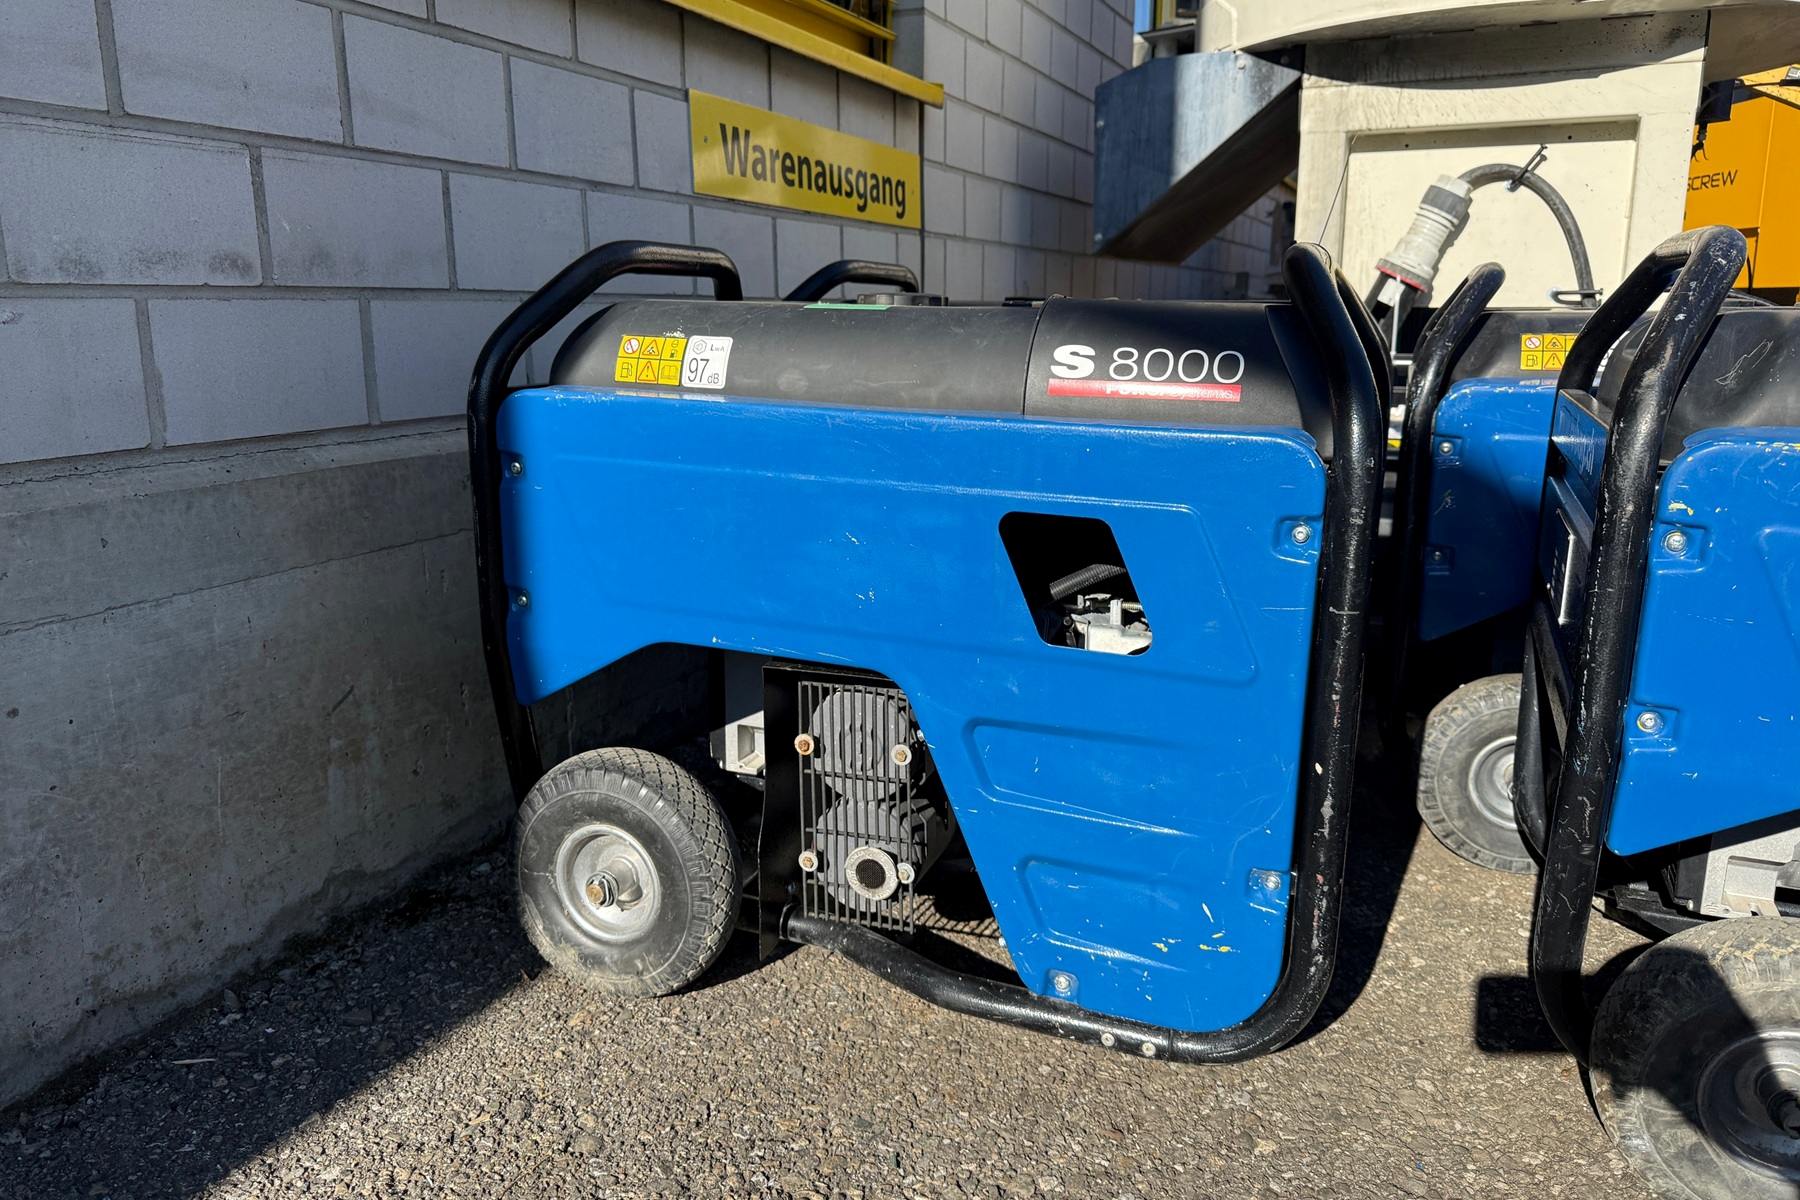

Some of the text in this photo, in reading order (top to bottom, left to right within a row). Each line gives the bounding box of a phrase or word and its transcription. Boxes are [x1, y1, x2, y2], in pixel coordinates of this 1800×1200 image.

[719, 122, 906, 219] Warenausgang
[687, 357, 720, 384] 97 dB
[1050, 344, 1245, 384] S 8000
